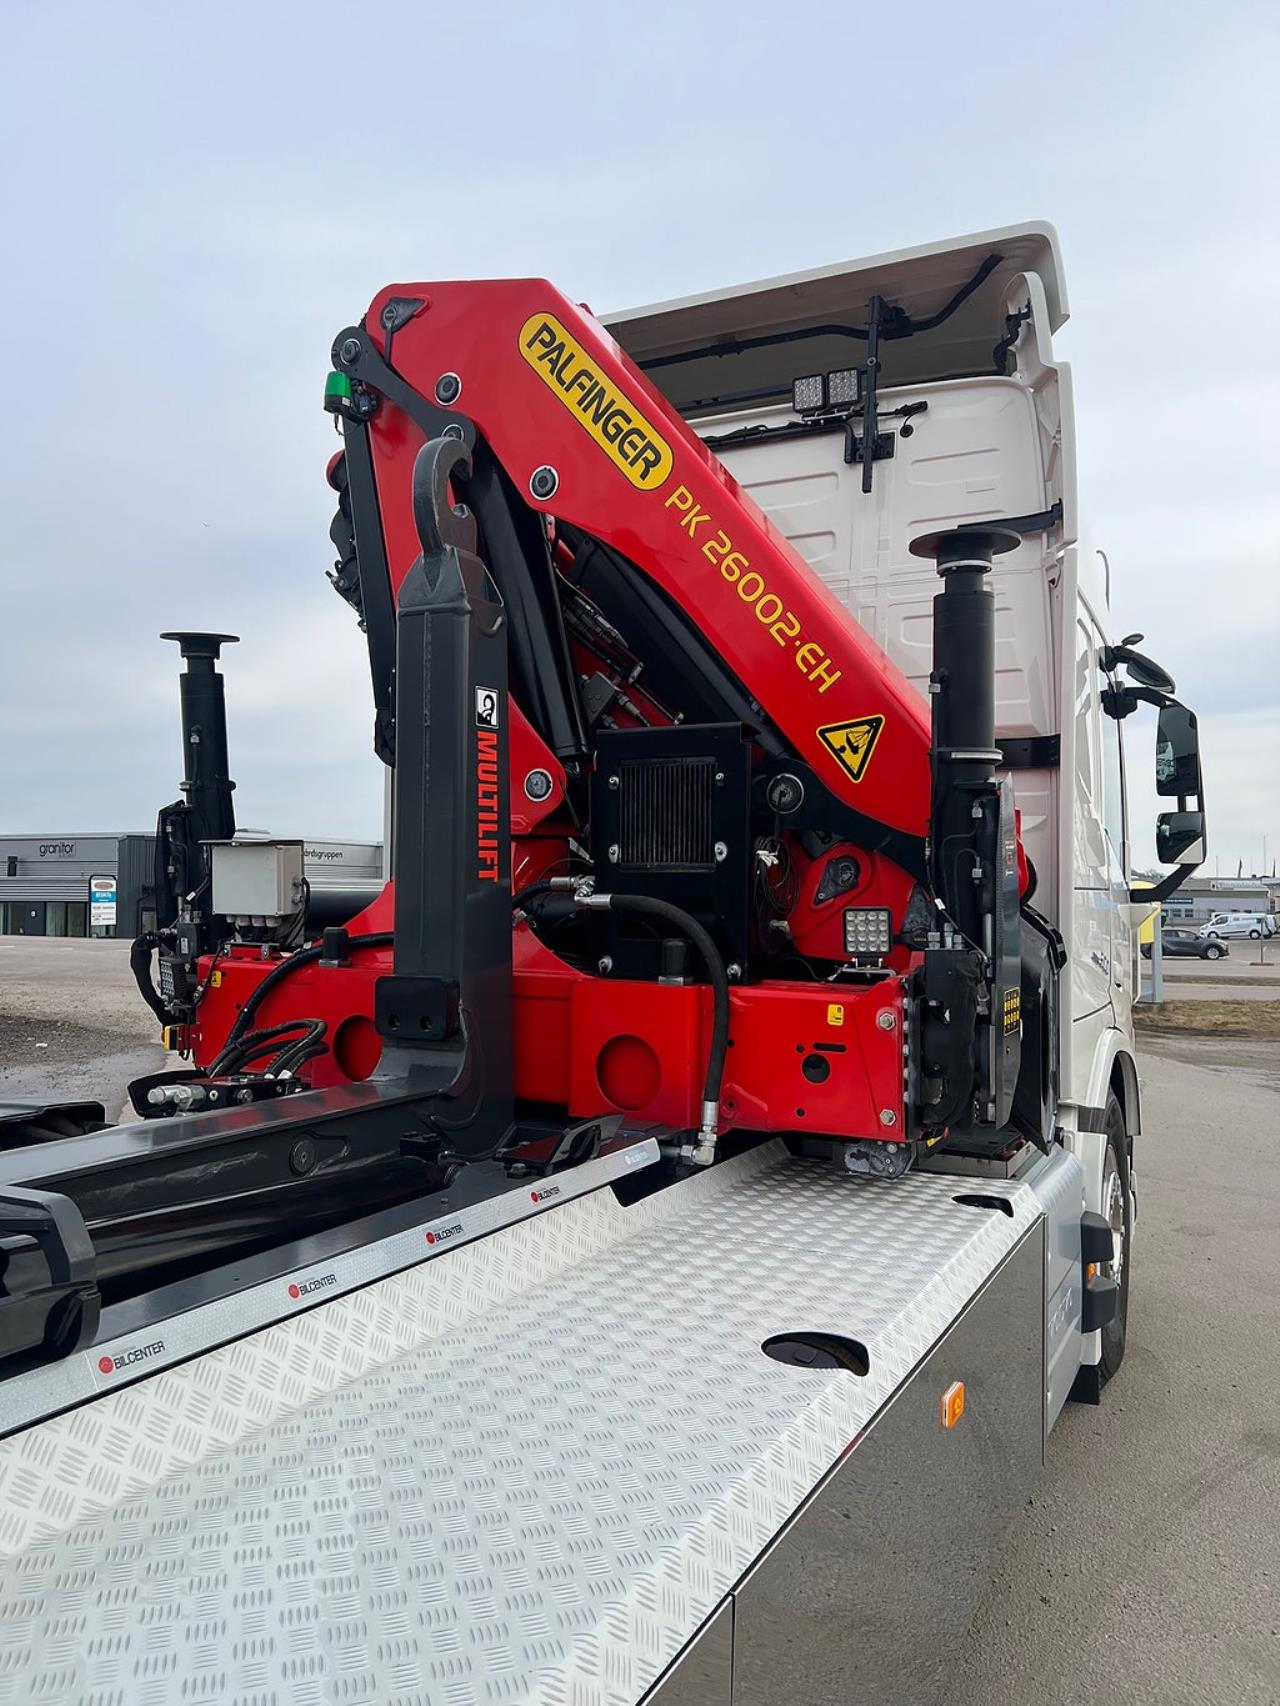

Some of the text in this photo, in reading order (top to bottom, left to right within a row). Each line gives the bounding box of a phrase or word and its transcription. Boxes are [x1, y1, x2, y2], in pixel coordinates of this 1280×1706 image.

[526, 322, 662, 481] PALFINGER
[665, 485, 711, 538] PK
[477, 730, 499, 882] MULTILIFT
[434, 1224, 463, 1242] BILCENTER
[299, 1274, 337, 1296] BILCENTER
[114, 1340, 166, 1369] BILCENTER
